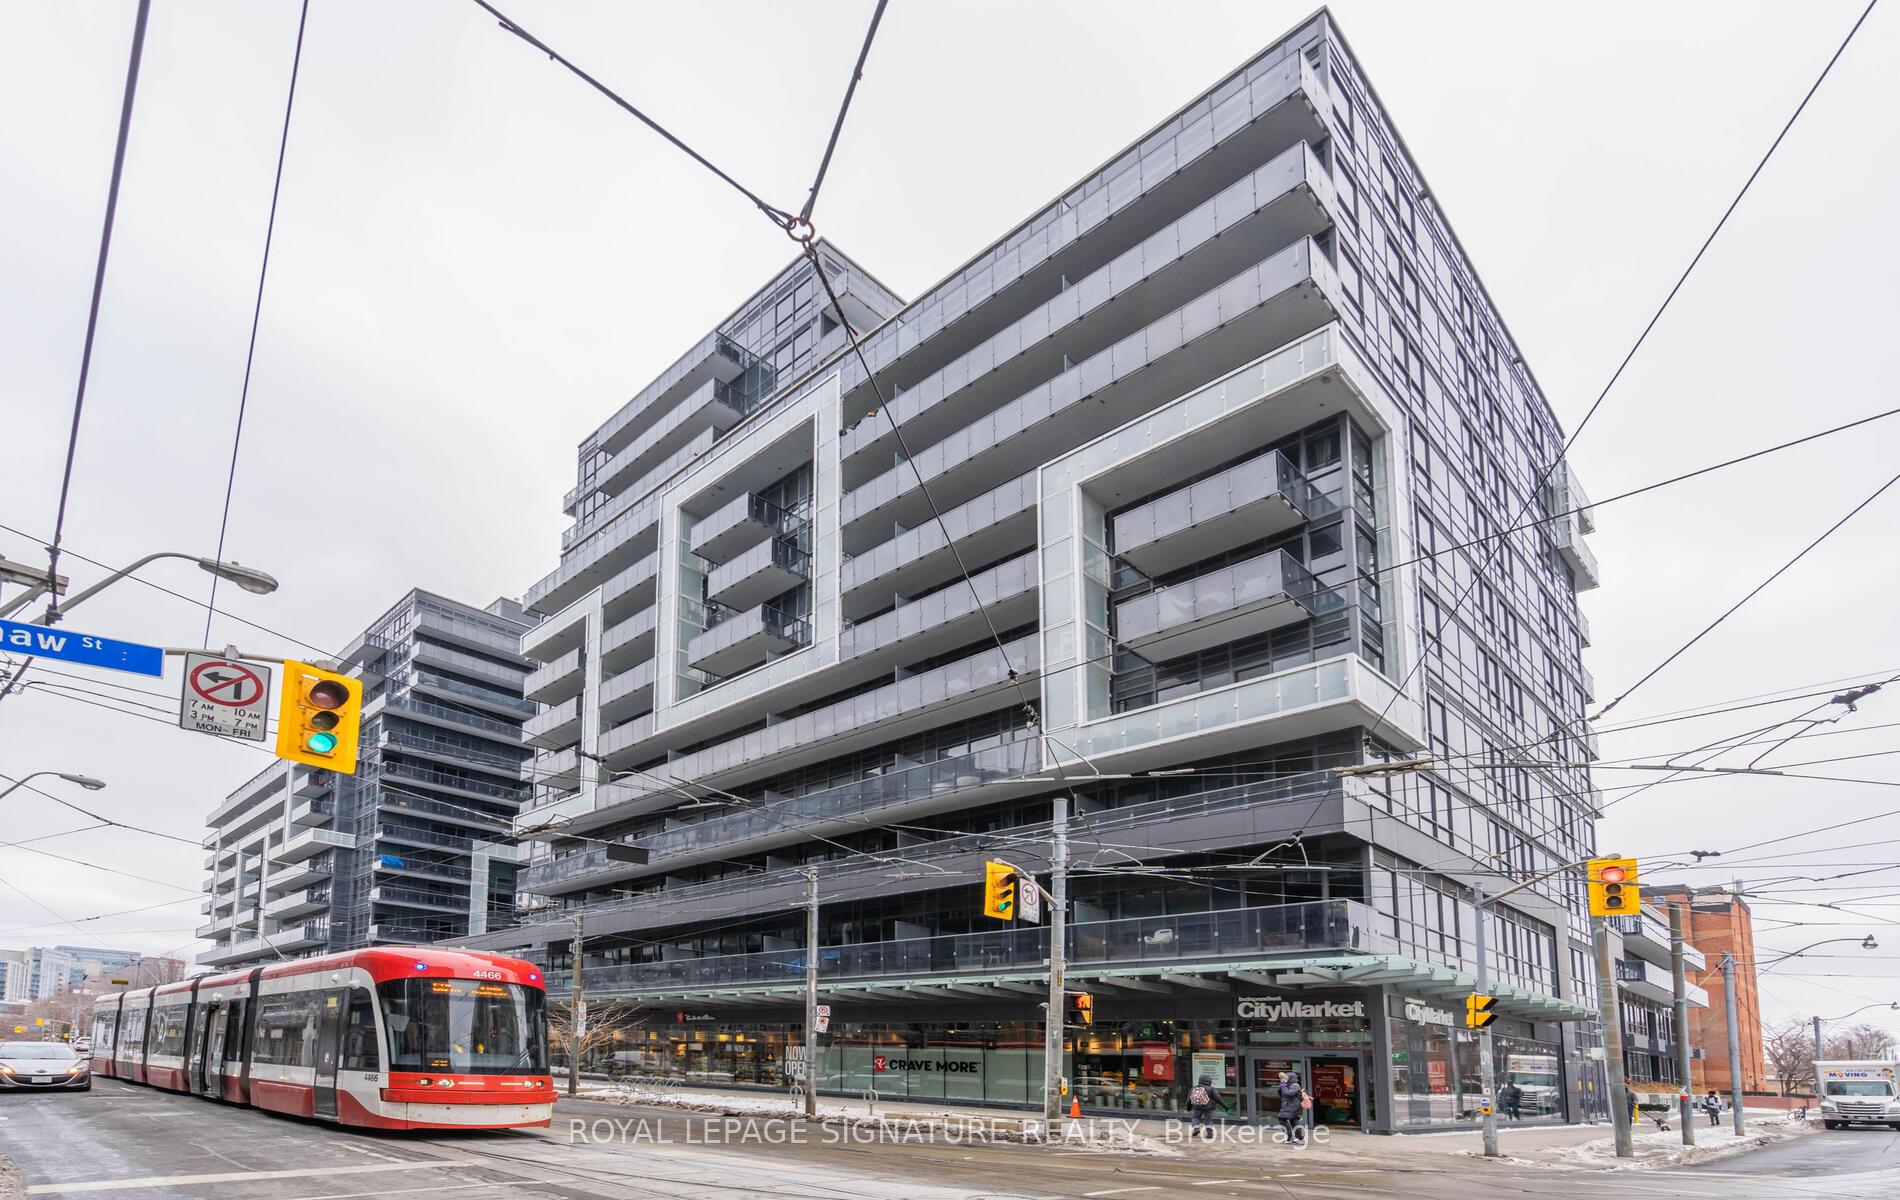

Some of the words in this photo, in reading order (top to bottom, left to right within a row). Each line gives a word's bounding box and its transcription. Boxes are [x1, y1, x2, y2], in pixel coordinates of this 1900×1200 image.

[0, 627, 66, 652] aw
[82, 637, 102, 650] St
[190, 710, 198, 719] 3
[201, 714, 214, 722] PM
[235, 719, 242, 727] 7
[246, 722, 258, 730] PM
[234, 708, 246, 717] 10
[196, 722, 222, 732] MON
[233, 729, 251, 737] FRI
[473, 970, 502, 980] 4466
[1237, 1001, 1365, 1022] CityMarket
[889, 1059, 932, 1072] CRAVE
